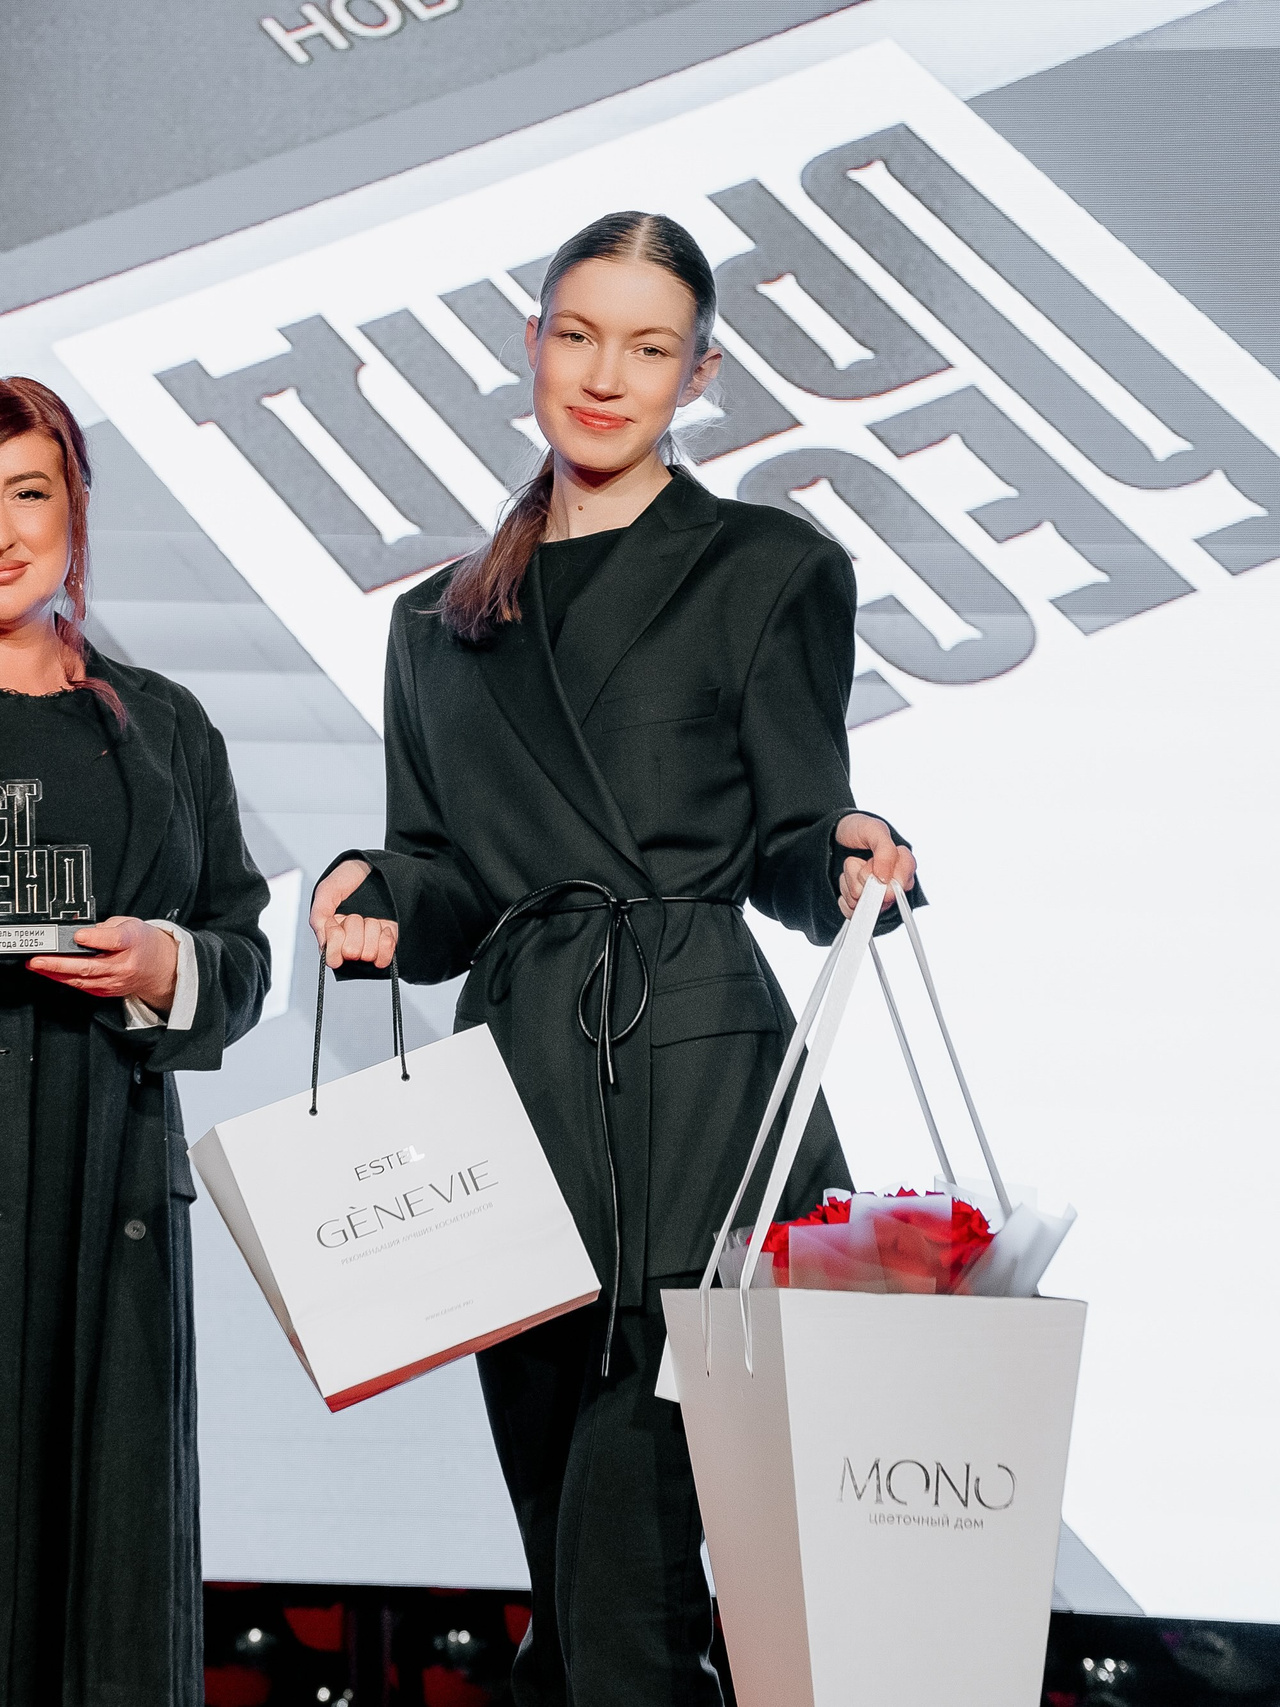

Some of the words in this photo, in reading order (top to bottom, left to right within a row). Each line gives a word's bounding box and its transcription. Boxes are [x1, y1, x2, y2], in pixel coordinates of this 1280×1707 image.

[260, 0, 464, 64] НО
[14, 929, 45, 938] премии
[19, 938, 44, 948] 2025»
[353, 1145, 426, 1182] ESTEL
[316, 1159, 499, 1249] GÈNEVIE
[837, 1456, 1017, 1511] MONO
[868, 1512, 951, 1529] цветочный
[952, 1517, 985, 1531] дом
